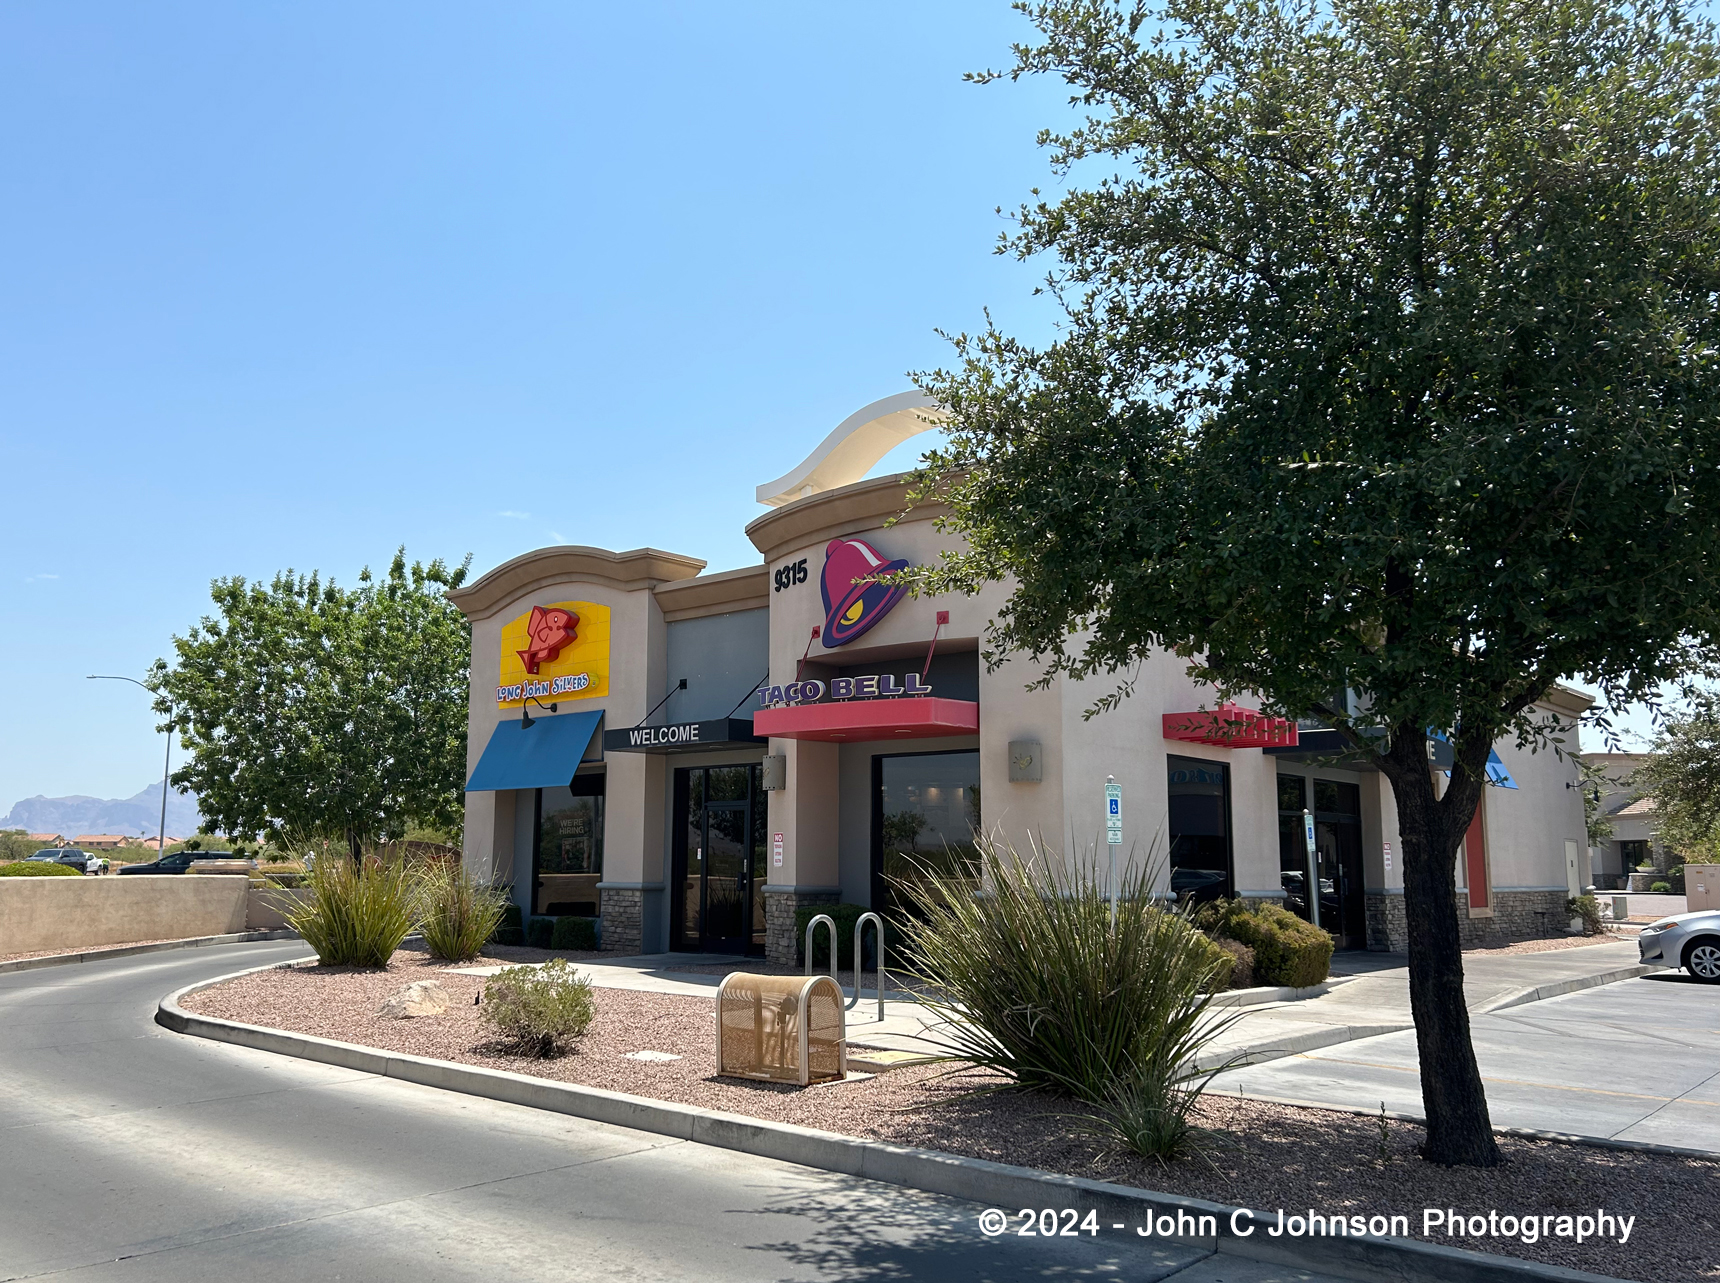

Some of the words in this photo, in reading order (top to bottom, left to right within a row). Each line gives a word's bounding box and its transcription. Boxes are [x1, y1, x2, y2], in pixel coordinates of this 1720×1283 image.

[774, 558, 808, 593] 9315
[757, 680, 826, 706] TACO
[831, 673, 932, 699] BELL
[629, 724, 700, 746] WELCOME
[559, 826, 585, 835] HIRING
[774, 834, 783, 842] NO
